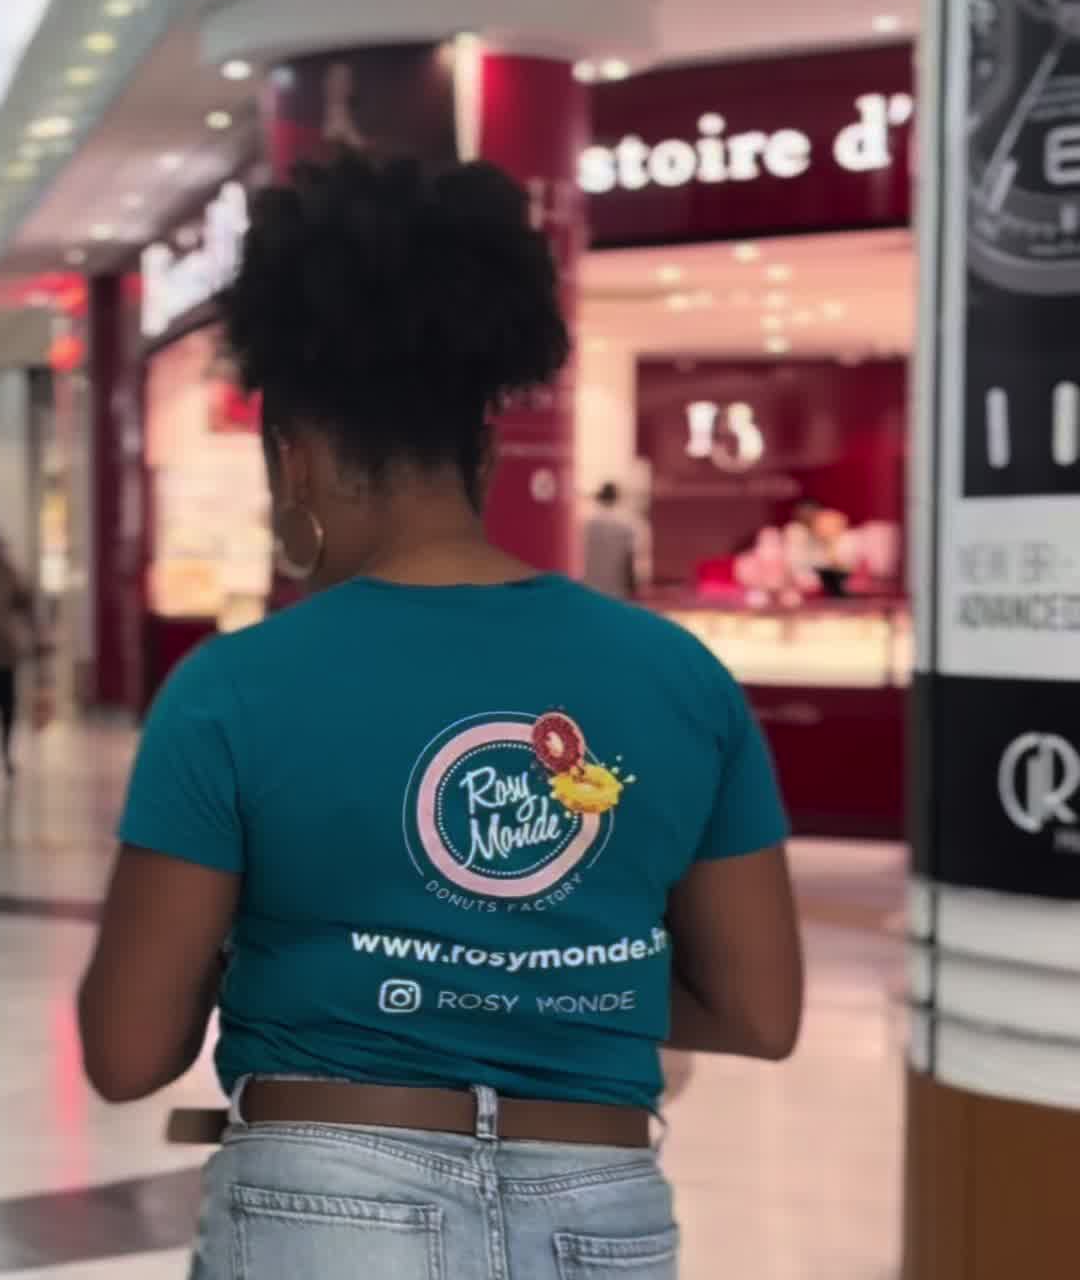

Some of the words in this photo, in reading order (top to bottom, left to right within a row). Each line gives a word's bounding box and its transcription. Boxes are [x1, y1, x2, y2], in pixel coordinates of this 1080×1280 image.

[576, 112, 811, 192] stoire
[459, 766, 538, 822] Rosy
[460, 796, 562, 868] Monde
[425, 879, 497, 912] DONUTS
[507, 872, 582, 912] FACTORY
[437, 991, 519, 1013] ROSY
[536, 990, 636, 1013] MONDE
